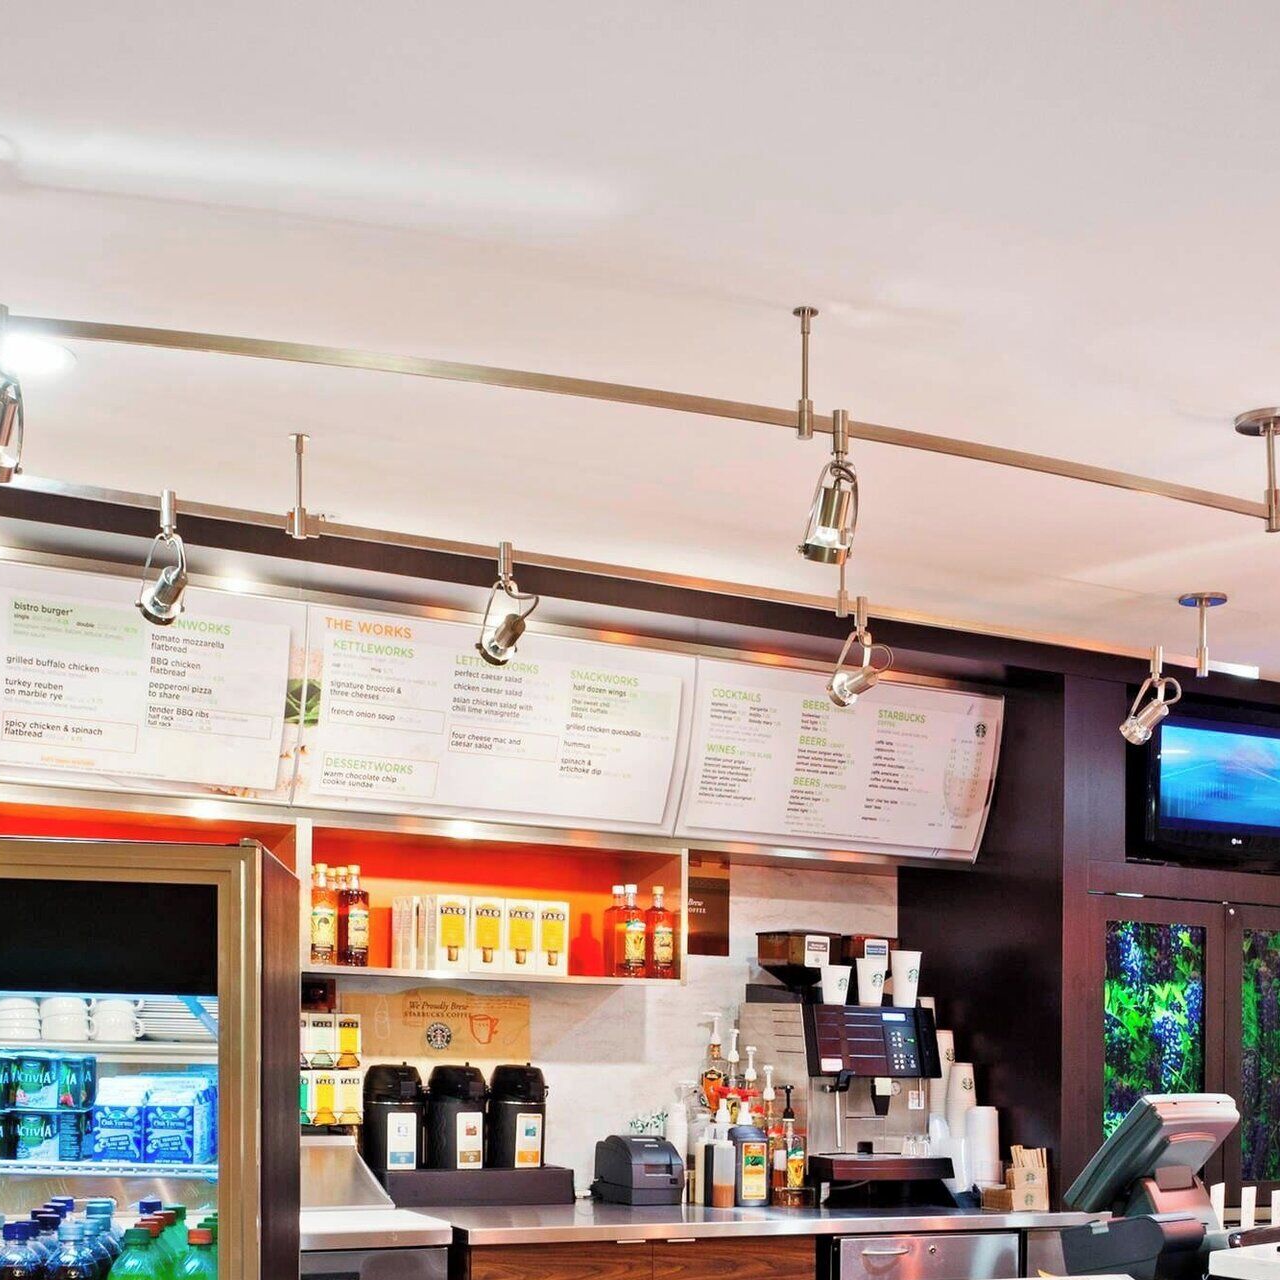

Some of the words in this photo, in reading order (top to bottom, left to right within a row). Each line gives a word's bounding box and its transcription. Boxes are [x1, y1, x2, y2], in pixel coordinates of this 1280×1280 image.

[14, 602, 39, 613] bistro
[325, 617, 352, 632] THE
[358, 621, 412, 639] WORKS
[151, 633, 181, 644] tomato
[183, 637, 225, 649] mozzarella
[151, 643, 188, 654] flatbread
[333, 639, 415, 659] KETTLEWORKS
[6, 656, 34, 666] grilled
[36, 657, 66, 669] buffalo
[68, 662, 100, 673] chicken
[150, 657, 169, 666] BBQ
[171, 660, 201, 670] chicken
[150, 666, 186, 677] flatbread
[454, 669, 480, 679] perfect
[570, 669, 639, 687] SNACKWORKS
[5, 678, 31, 689] turkey
[34, 681, 64, 691] reuben
[148, 682, 190, 693] pepperoni
[192, 686, 213, 695] pizza
[330, 680, 364, 691] signature
[366, 684, 395, 694] broccoli
[453, 682, 480, 692] chicken
[18, 689, 48, 699] marble
[50, 693, 63, 701] rye
[159, 692, 181, 701] share
[330, 688, 349, 697] three
[351, 690, 380, 700] cheeses
[712, 688, 762, 703] COCKTAILS
[802, 699, 831, 712] BEERS
[149, 705, 174, 715] tender
[176, 708, 193, 717] BBQ
[195, 710, 209, 719] ribs
[331, 707, 354, 717] french
[355, 710, 376, 719] onion
[878, 709, 927, 724] STARBUCKS
[4, 727, 43, 738] flatbread
[5, 719, 27, 729] spicy
[29, 721, 61, 731] chicken
[71, 726, 103, 736] spinach
[799, 735, 827, 747] BEERS
[706, 743, 736, 755] WINES
[325, 757, 414, 776] DESSERTWORKS
[322, 778, 346, 786] cookie
[348, 780, 374, 788] sundae
[345, 771, 380, 782] chocolate
[381, 775, 397, 783] chip
[793, 776, 821, 788] BEERS
[440, 906, 466, 916] TAZO
[475, 908, 501, 918] TAZO
[509, 910, 535, 920] TAZO
[541, 911, 566, 921] TAZO
[409, 1001, 420, 1010] We
[422, 1001, 449, 1012] Proudly
